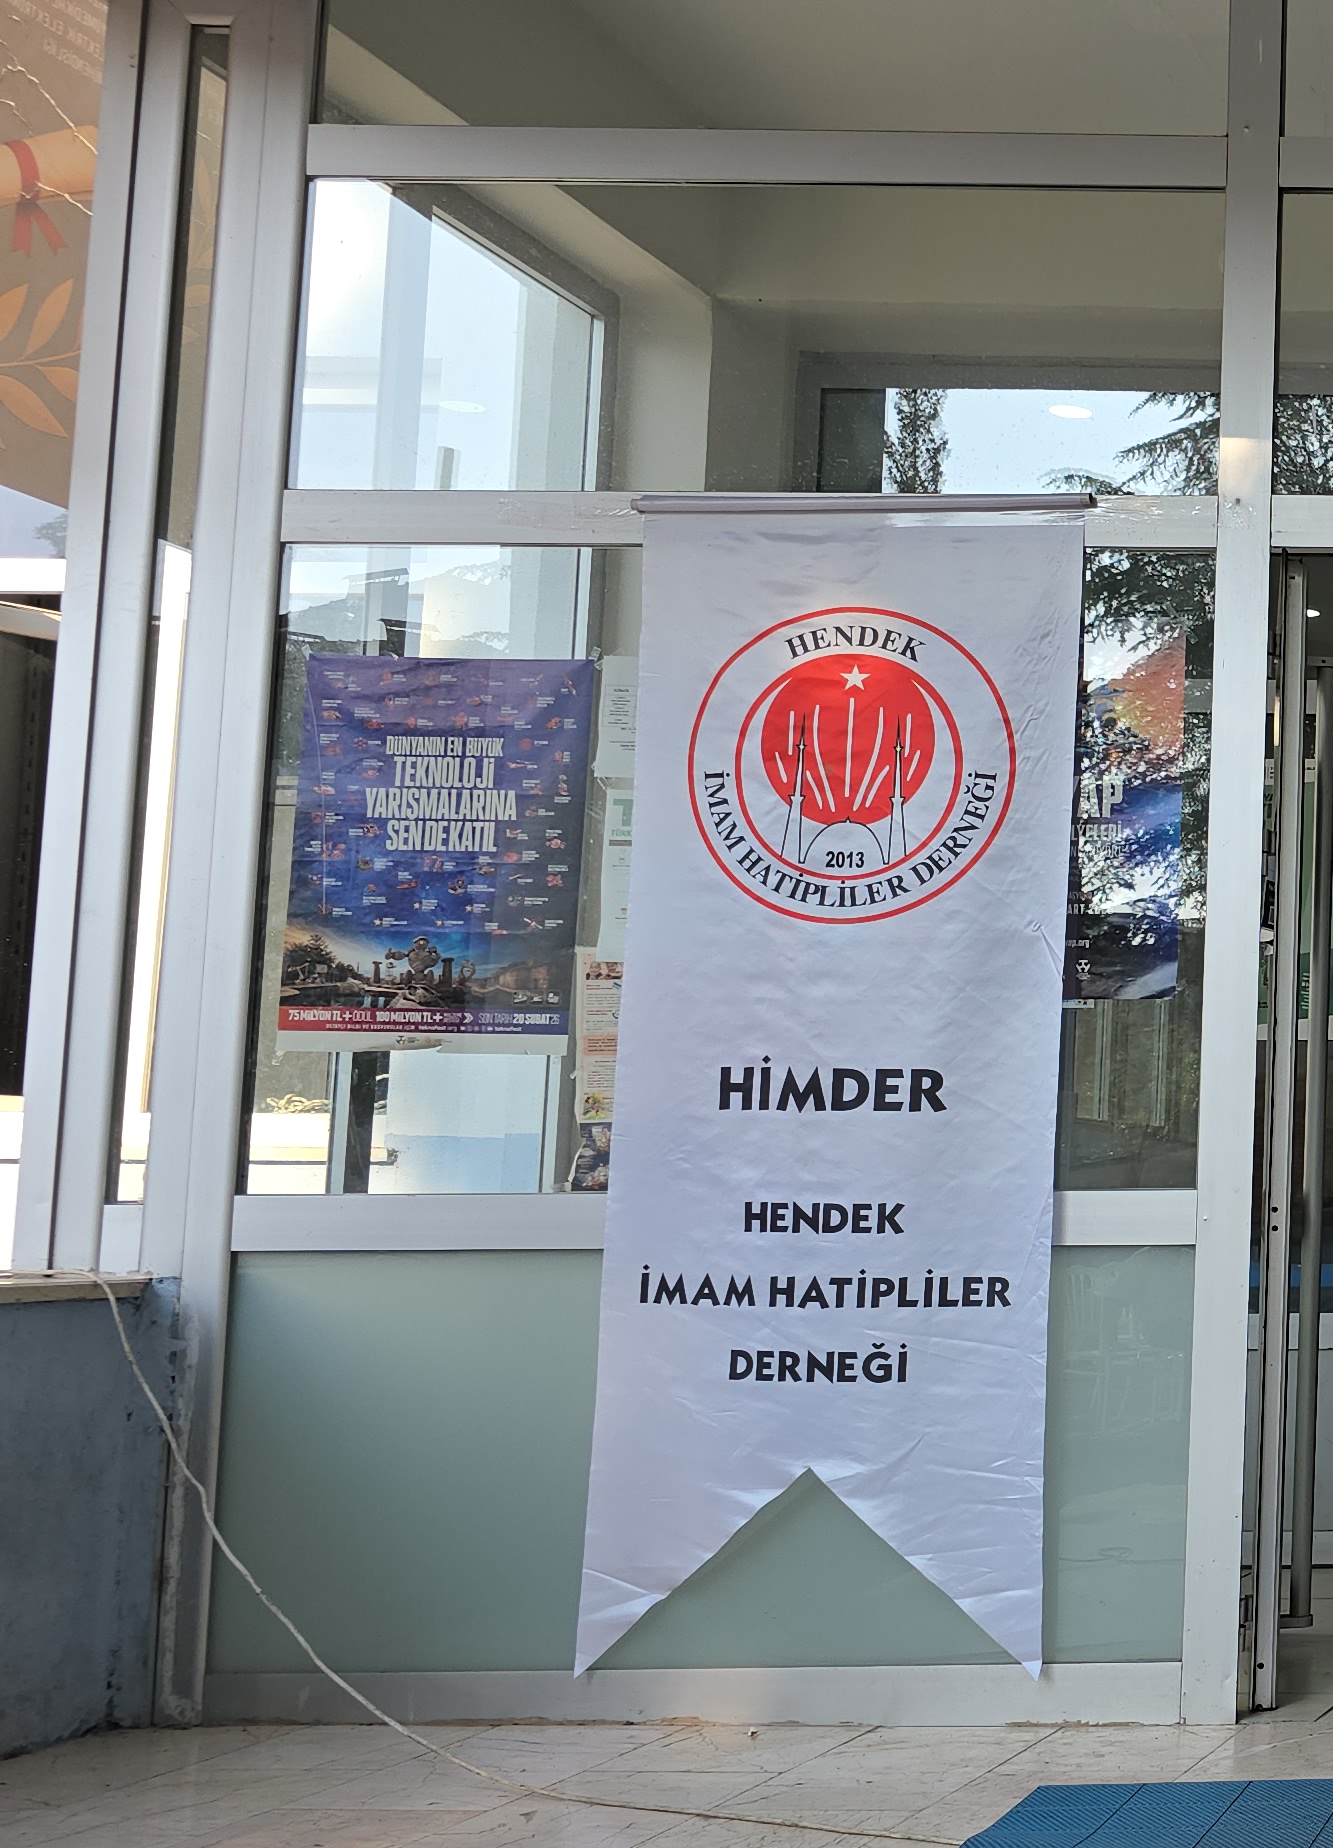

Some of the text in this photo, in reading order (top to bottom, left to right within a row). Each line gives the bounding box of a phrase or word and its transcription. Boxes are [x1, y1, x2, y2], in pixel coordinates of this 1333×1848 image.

[784, 625, 926, 663] HENDEK
[386, 735, 504, 757] DÜNYANIN EN BÜYÜK
[393, 756, 495, 788] TEKNOLOJİ
[365, 787, 517, 821] YARIŞMALARINA
[703, 770, 998, 909] İMAM HATİPLİLER DERNEĞİ
[825, 851, 865, 869] 2013
[289, 1010, 299, 1020] 75
[332, 1010, 342, 1021] TL
[376, 1011, 390, 1021] 100
[423, 1012, 433, 1023] TL
[718, 1055, 948, 1114] HİMDER
[743, 1201, 905, 1235] HENDEK
[639, 1264, 1012, 1309] İMAM HATİPLİLER
[728, 1342, 909, 1384] DERNEĞİ
